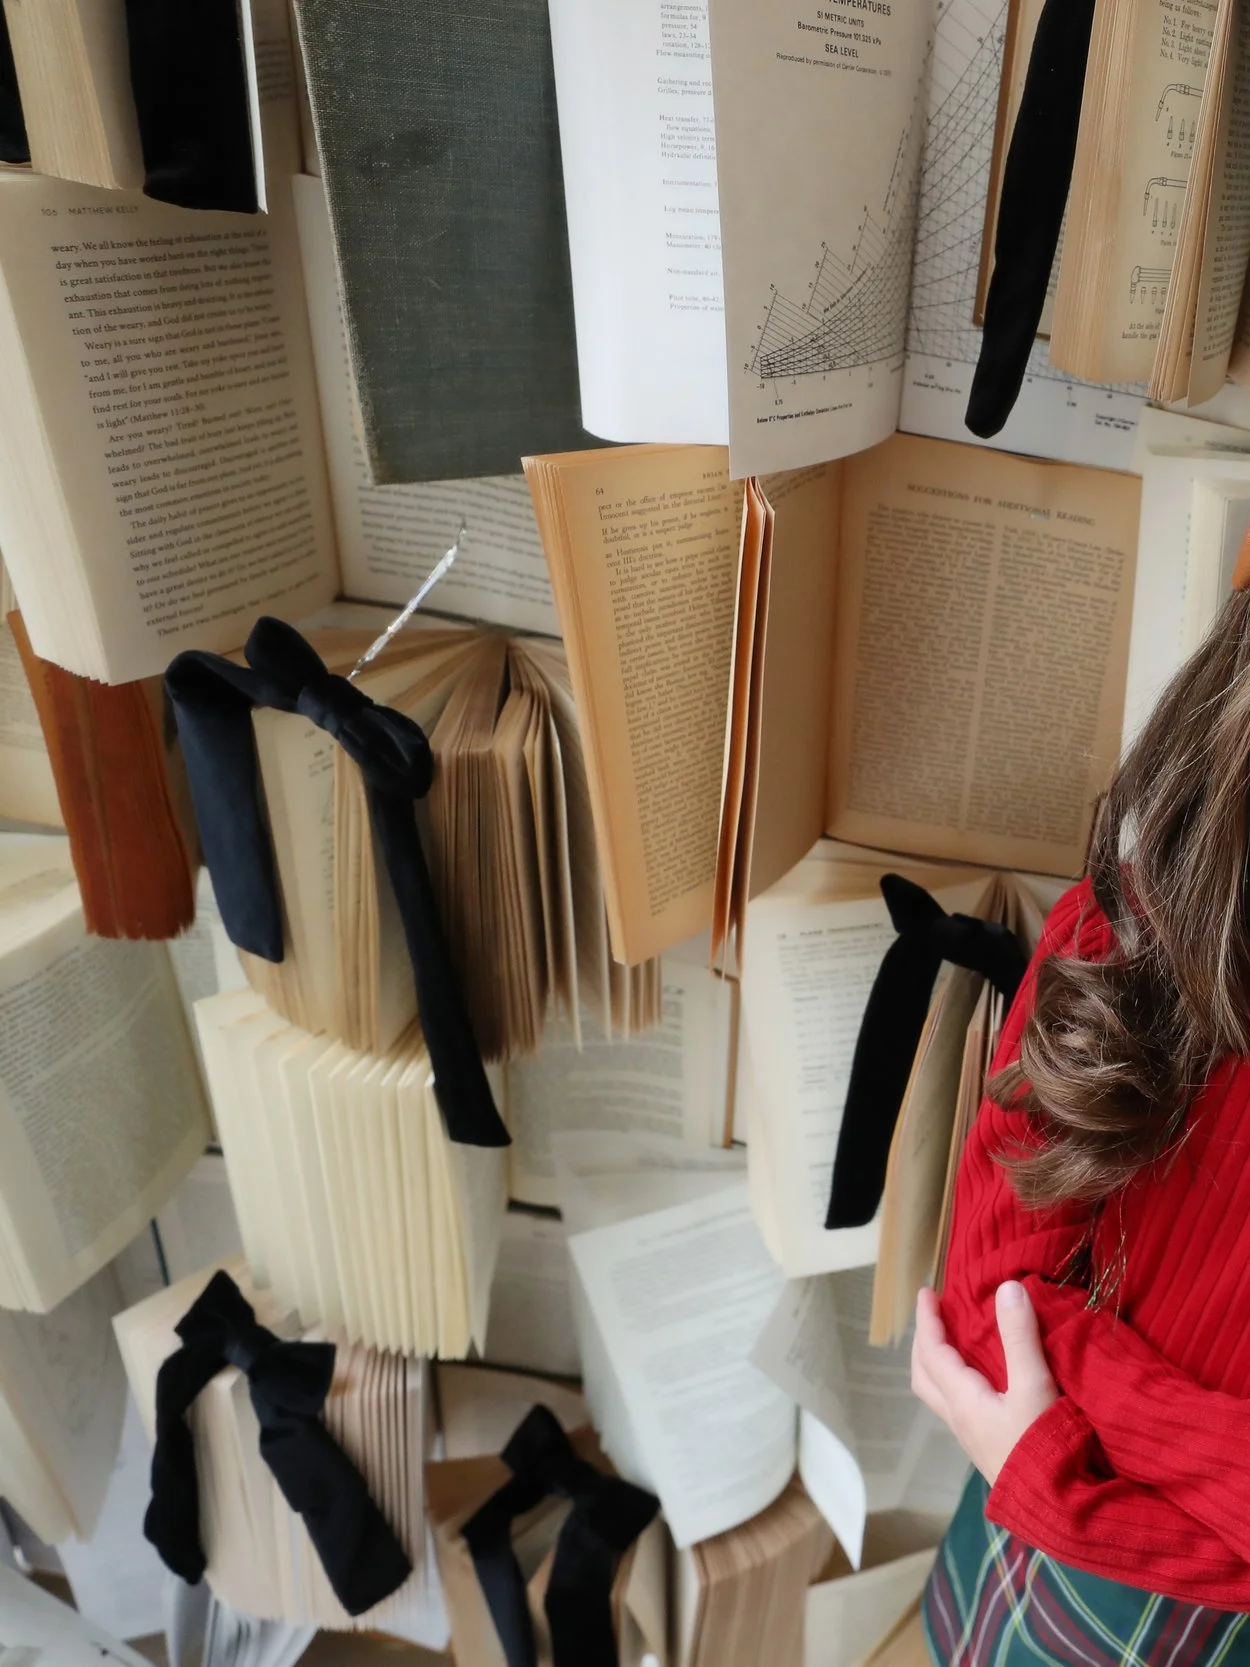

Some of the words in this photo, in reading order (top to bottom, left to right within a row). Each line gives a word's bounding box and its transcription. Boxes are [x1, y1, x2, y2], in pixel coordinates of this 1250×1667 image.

[825, 12, 846, 24] METRIC
[849, 18, 864, 28] UNITS
[798, 21, 828, 35] Barometric
[830, 28, 852, 39] Pressure
[776, 53, 804, 63] Reproduced
[825, 44, 838, 54] SEA
[840, 47, 858, 58] LEVEL
[68, 206, 113, 215] MATTHEW
[51, 244, 82, 254] weary.
[82, 242, 97, 250] We
[99, 241, 109, 250] all
[111, 240, 134, 249] know
[136, 239, 148, 247] the
[55, 261, 72, 271] day
[74, 260, 98, 268] when
[100, 260, 116, 268] you
[118, 257, 137, 265] have
[139, 254, 167, 263] worked
[70, 277, 92, 288] great
[95, 273, 141, 284] satisfaction
[64, 291, 112, 303] exhaustion
[114, 290, 131, 298] that
[132, 288, 158, 297] comes
[69, 311, 85, 319] ant.
[87, 308, 107, 318] This
[108, 304, 152, 315] exhaustion
[72, 327, 91, 336] tion
[93, 324, 102, 333] of
[104, 324, 117, 332] the
[119, 322, 146, 330] weary,
[84, 340, 112, 350] Weary
[113, 354, 123, 364] all
[144, 350, 162, 359] who
[93, 404, 111, 414] find
[112, 402, 128, 411] rest
[130, 399, 141, 408] for
[104, 445, 145, 459] whelmed?
[148, 442, 163, 451] The
[108, 464, 130, 474] leads
[595, 487, 604, 495] 64
[626, 498, 636, 507] the
[973, 494, 993, 506] FOR
[1056, 510, 1096, 527] READING
